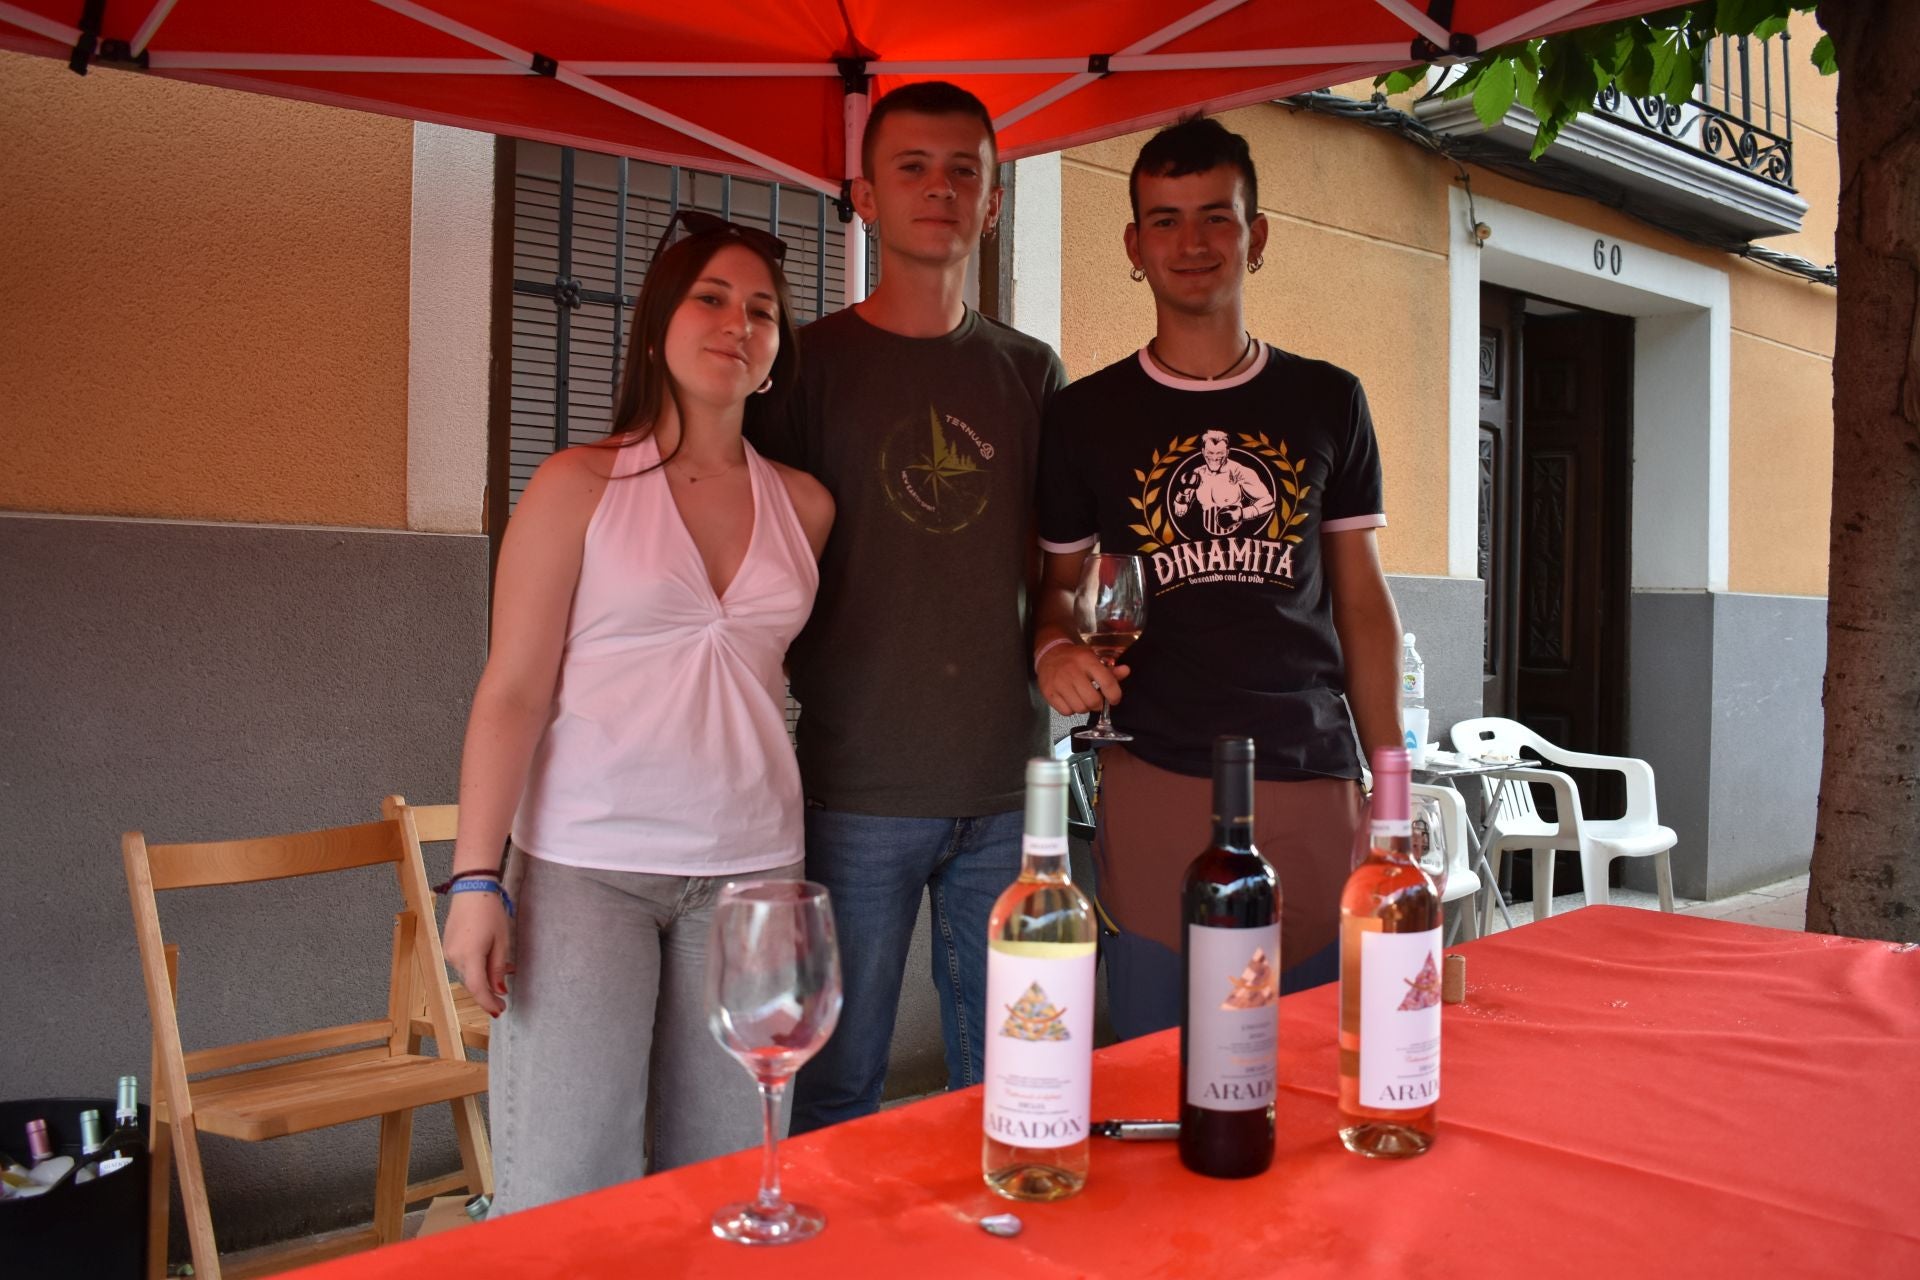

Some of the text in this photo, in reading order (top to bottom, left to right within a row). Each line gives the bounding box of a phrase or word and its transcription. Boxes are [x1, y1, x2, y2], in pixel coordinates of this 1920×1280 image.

[1593, 239, 1622, 276] 60
[945, 414, 982, 448] TERNUA
[1151, 537, 1294, 585] DINAMITA
[1189, 573, 1224, 585] boxeando
[1238, 572, 1247, 583] la
[1248, 574, 1265, 584] vida
